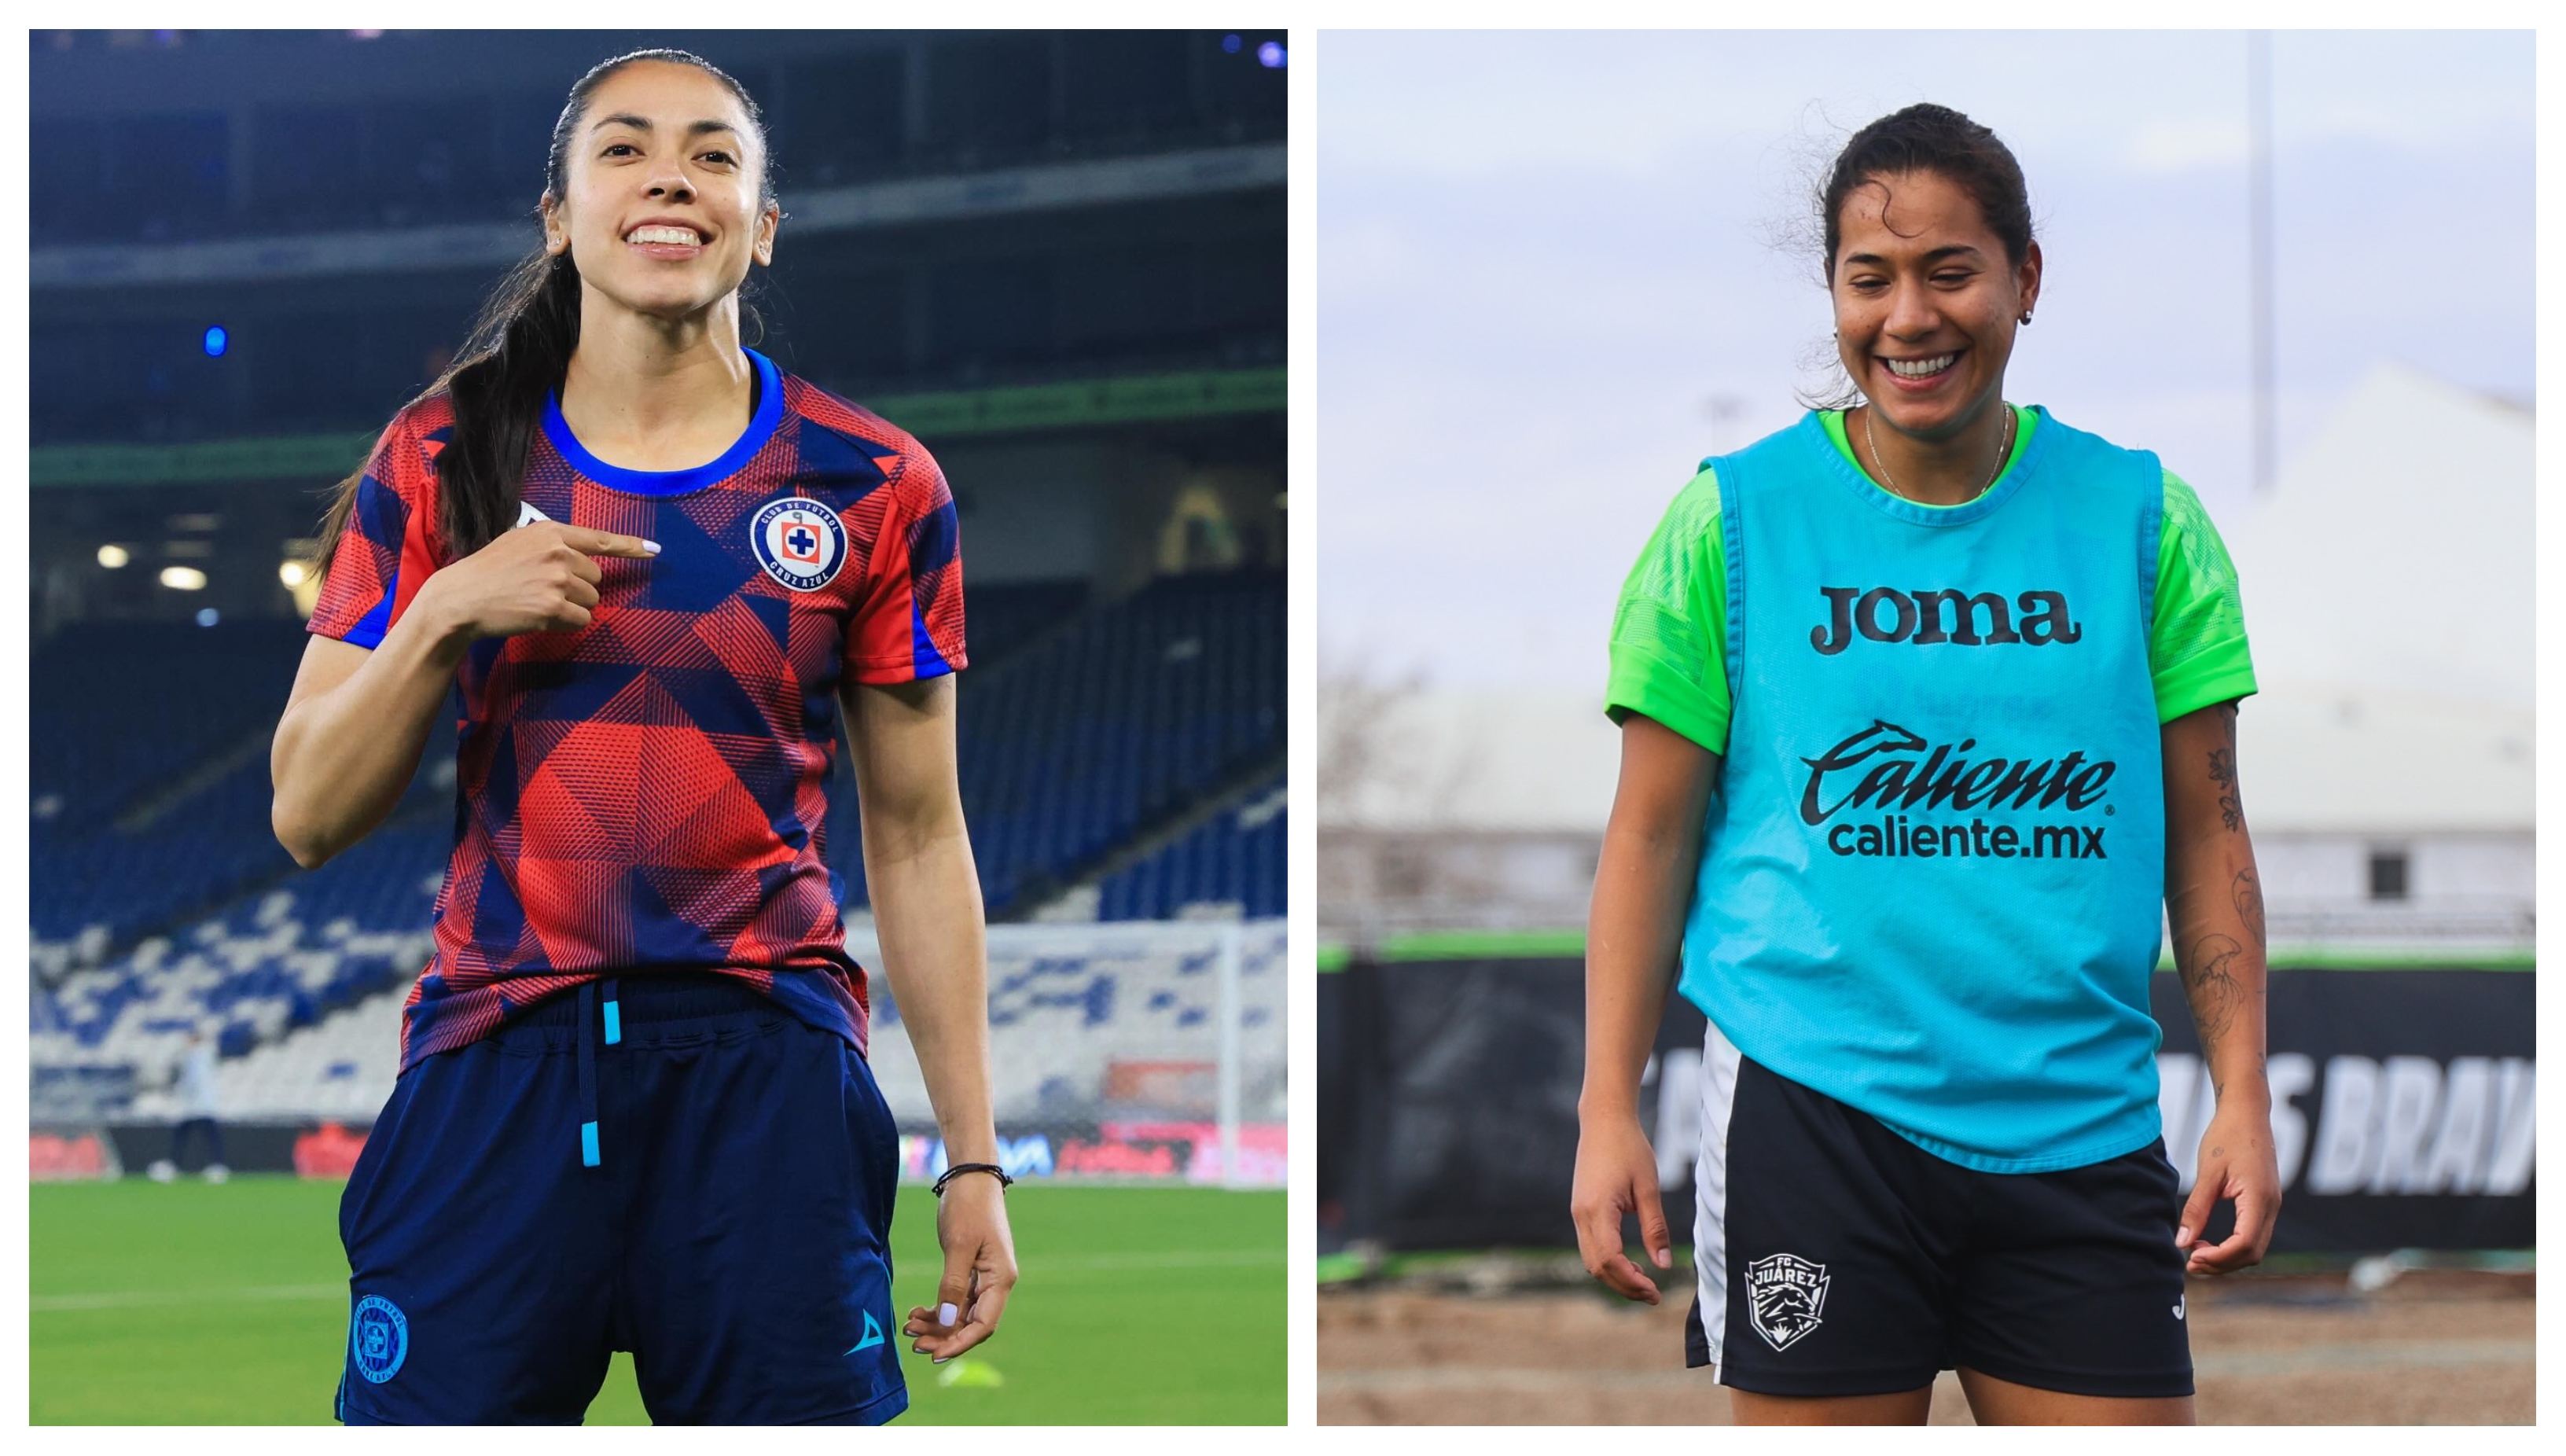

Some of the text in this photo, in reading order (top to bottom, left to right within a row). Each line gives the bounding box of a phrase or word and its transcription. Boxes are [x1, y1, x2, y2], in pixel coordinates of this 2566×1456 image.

[760, 507, 782, 524] CLUB
[806, 504, 839, 532] FUTBOL
[770, 561, 829, 587] CRUZ AZUL
[1800, 719, 2116, 825] Caliente
[1828, 815, 2108, 859] caliente.mx
[1777, 1257, 1792, 1267] FC
[1755, 1266, 1818, 1287] JUÁREZ
